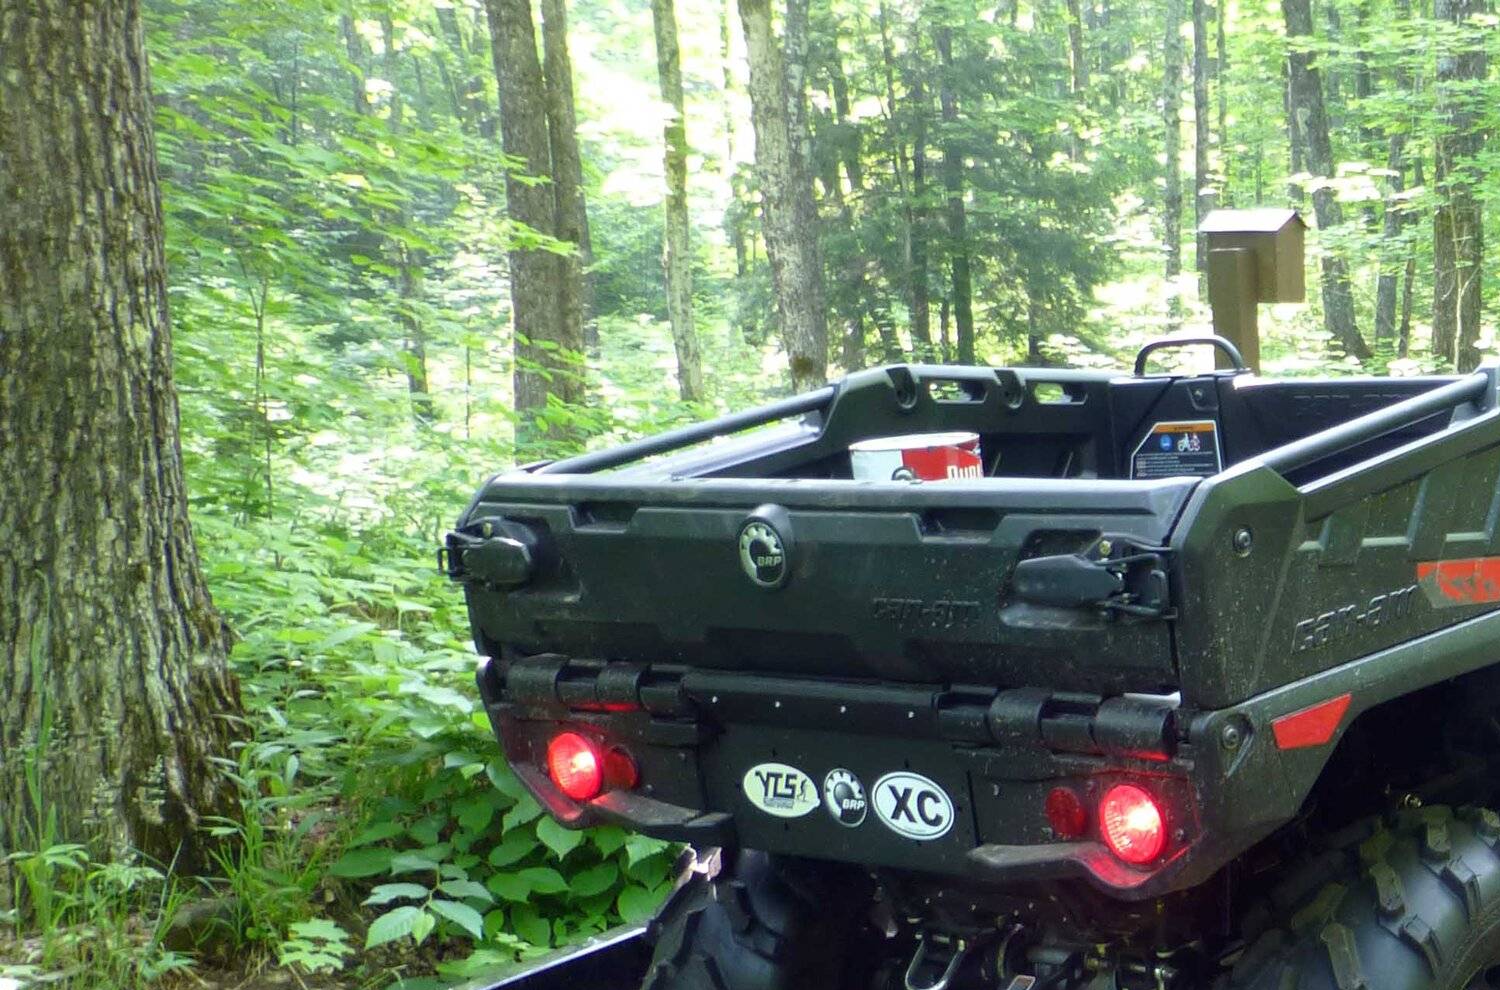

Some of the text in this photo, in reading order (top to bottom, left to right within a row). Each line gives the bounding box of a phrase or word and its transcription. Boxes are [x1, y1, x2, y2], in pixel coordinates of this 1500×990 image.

[757, 555, 782, 567] BRP
[841, 798, 866, 811] BRP
[888, 783, 944, 827] XC
